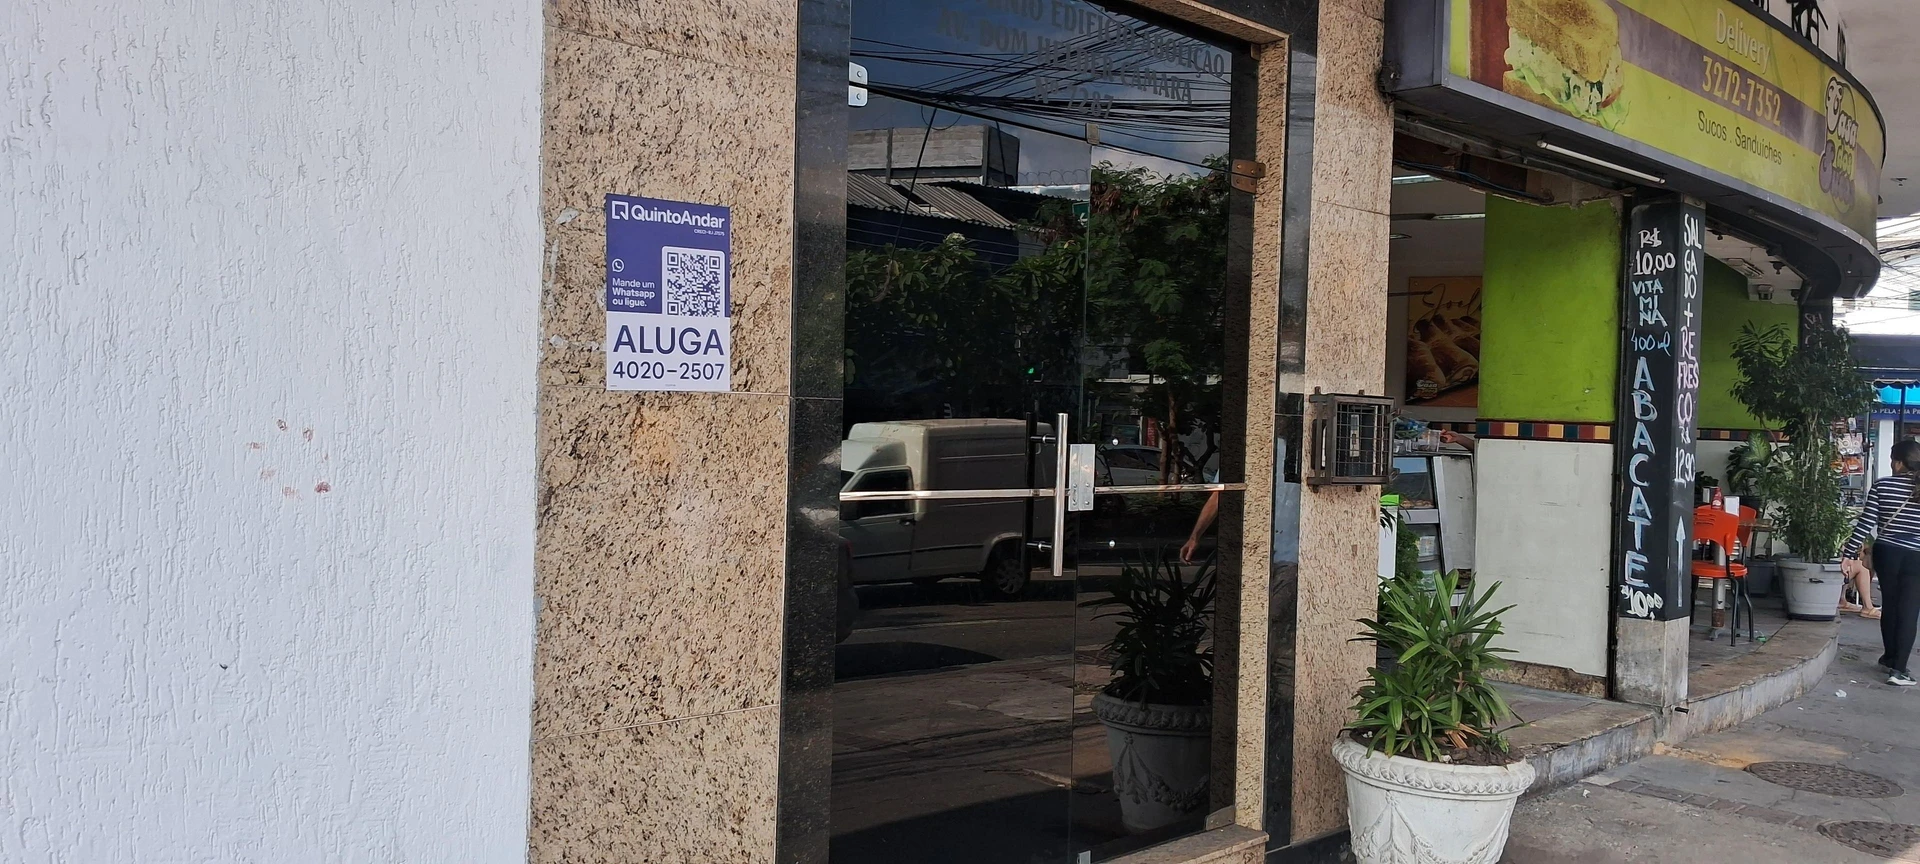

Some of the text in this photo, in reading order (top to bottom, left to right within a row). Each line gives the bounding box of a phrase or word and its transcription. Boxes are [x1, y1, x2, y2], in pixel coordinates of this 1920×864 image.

[936, 7, 969, 41] AV.
[980, 19, 1028, 58] DOM
[1037, 36, 1115, 82] HELDER
[1716, 8, 1770, 74] Delivery
[1067, 84, 1114, 119] 7287
[1702, 55, 1781, 126] 3272-7352
[1698, 109, 1727, 142] Sucos
[631, 205, 725, 229] QuintoAndar
[1638, 228, 1662, 248] R$
[1684, 213, 1702, 249] SAL
[1633, 251, 1676, 276] 10,00
[1684, 250, 1698, 275] GA
[612, 278, 641, 288] Mande
[612, 287, 656, 299] Whatsapp
[1632, 279, 1664, 296] VITA
[624, 298, 647, 308] ligue.
[1639, 296, 1658, 311] MI
[1639, 309, 1668, 327] NA
[612, 324, 725, 357] ALUGA
[1680, 325, 1696, 360] RE
[612, 360, 725, 381] 4020-2507
[1677, 361, 1699, 390] FRES
[1677, 393, 1693, 424] CO
